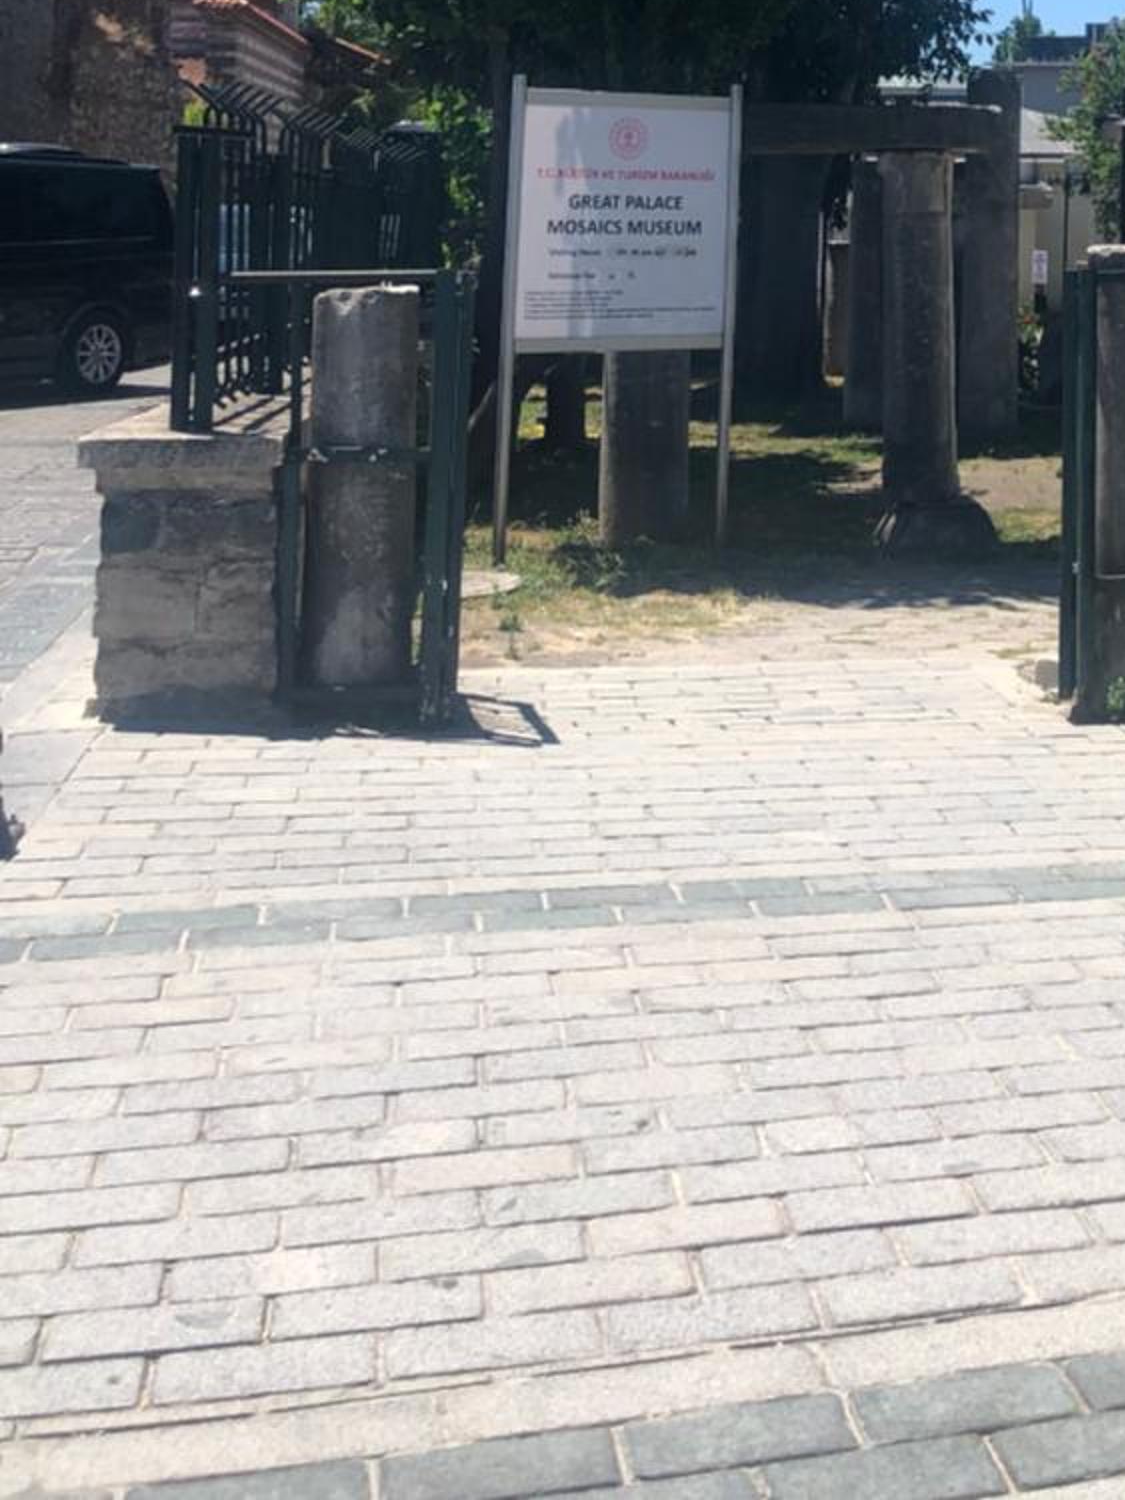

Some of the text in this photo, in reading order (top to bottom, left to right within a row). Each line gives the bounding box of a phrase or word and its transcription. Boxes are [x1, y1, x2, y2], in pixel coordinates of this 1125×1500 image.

[569, 193, 684, 211] GREAT PALACE
[547, 219, 703, 236] MOSAICS MUSEUM
